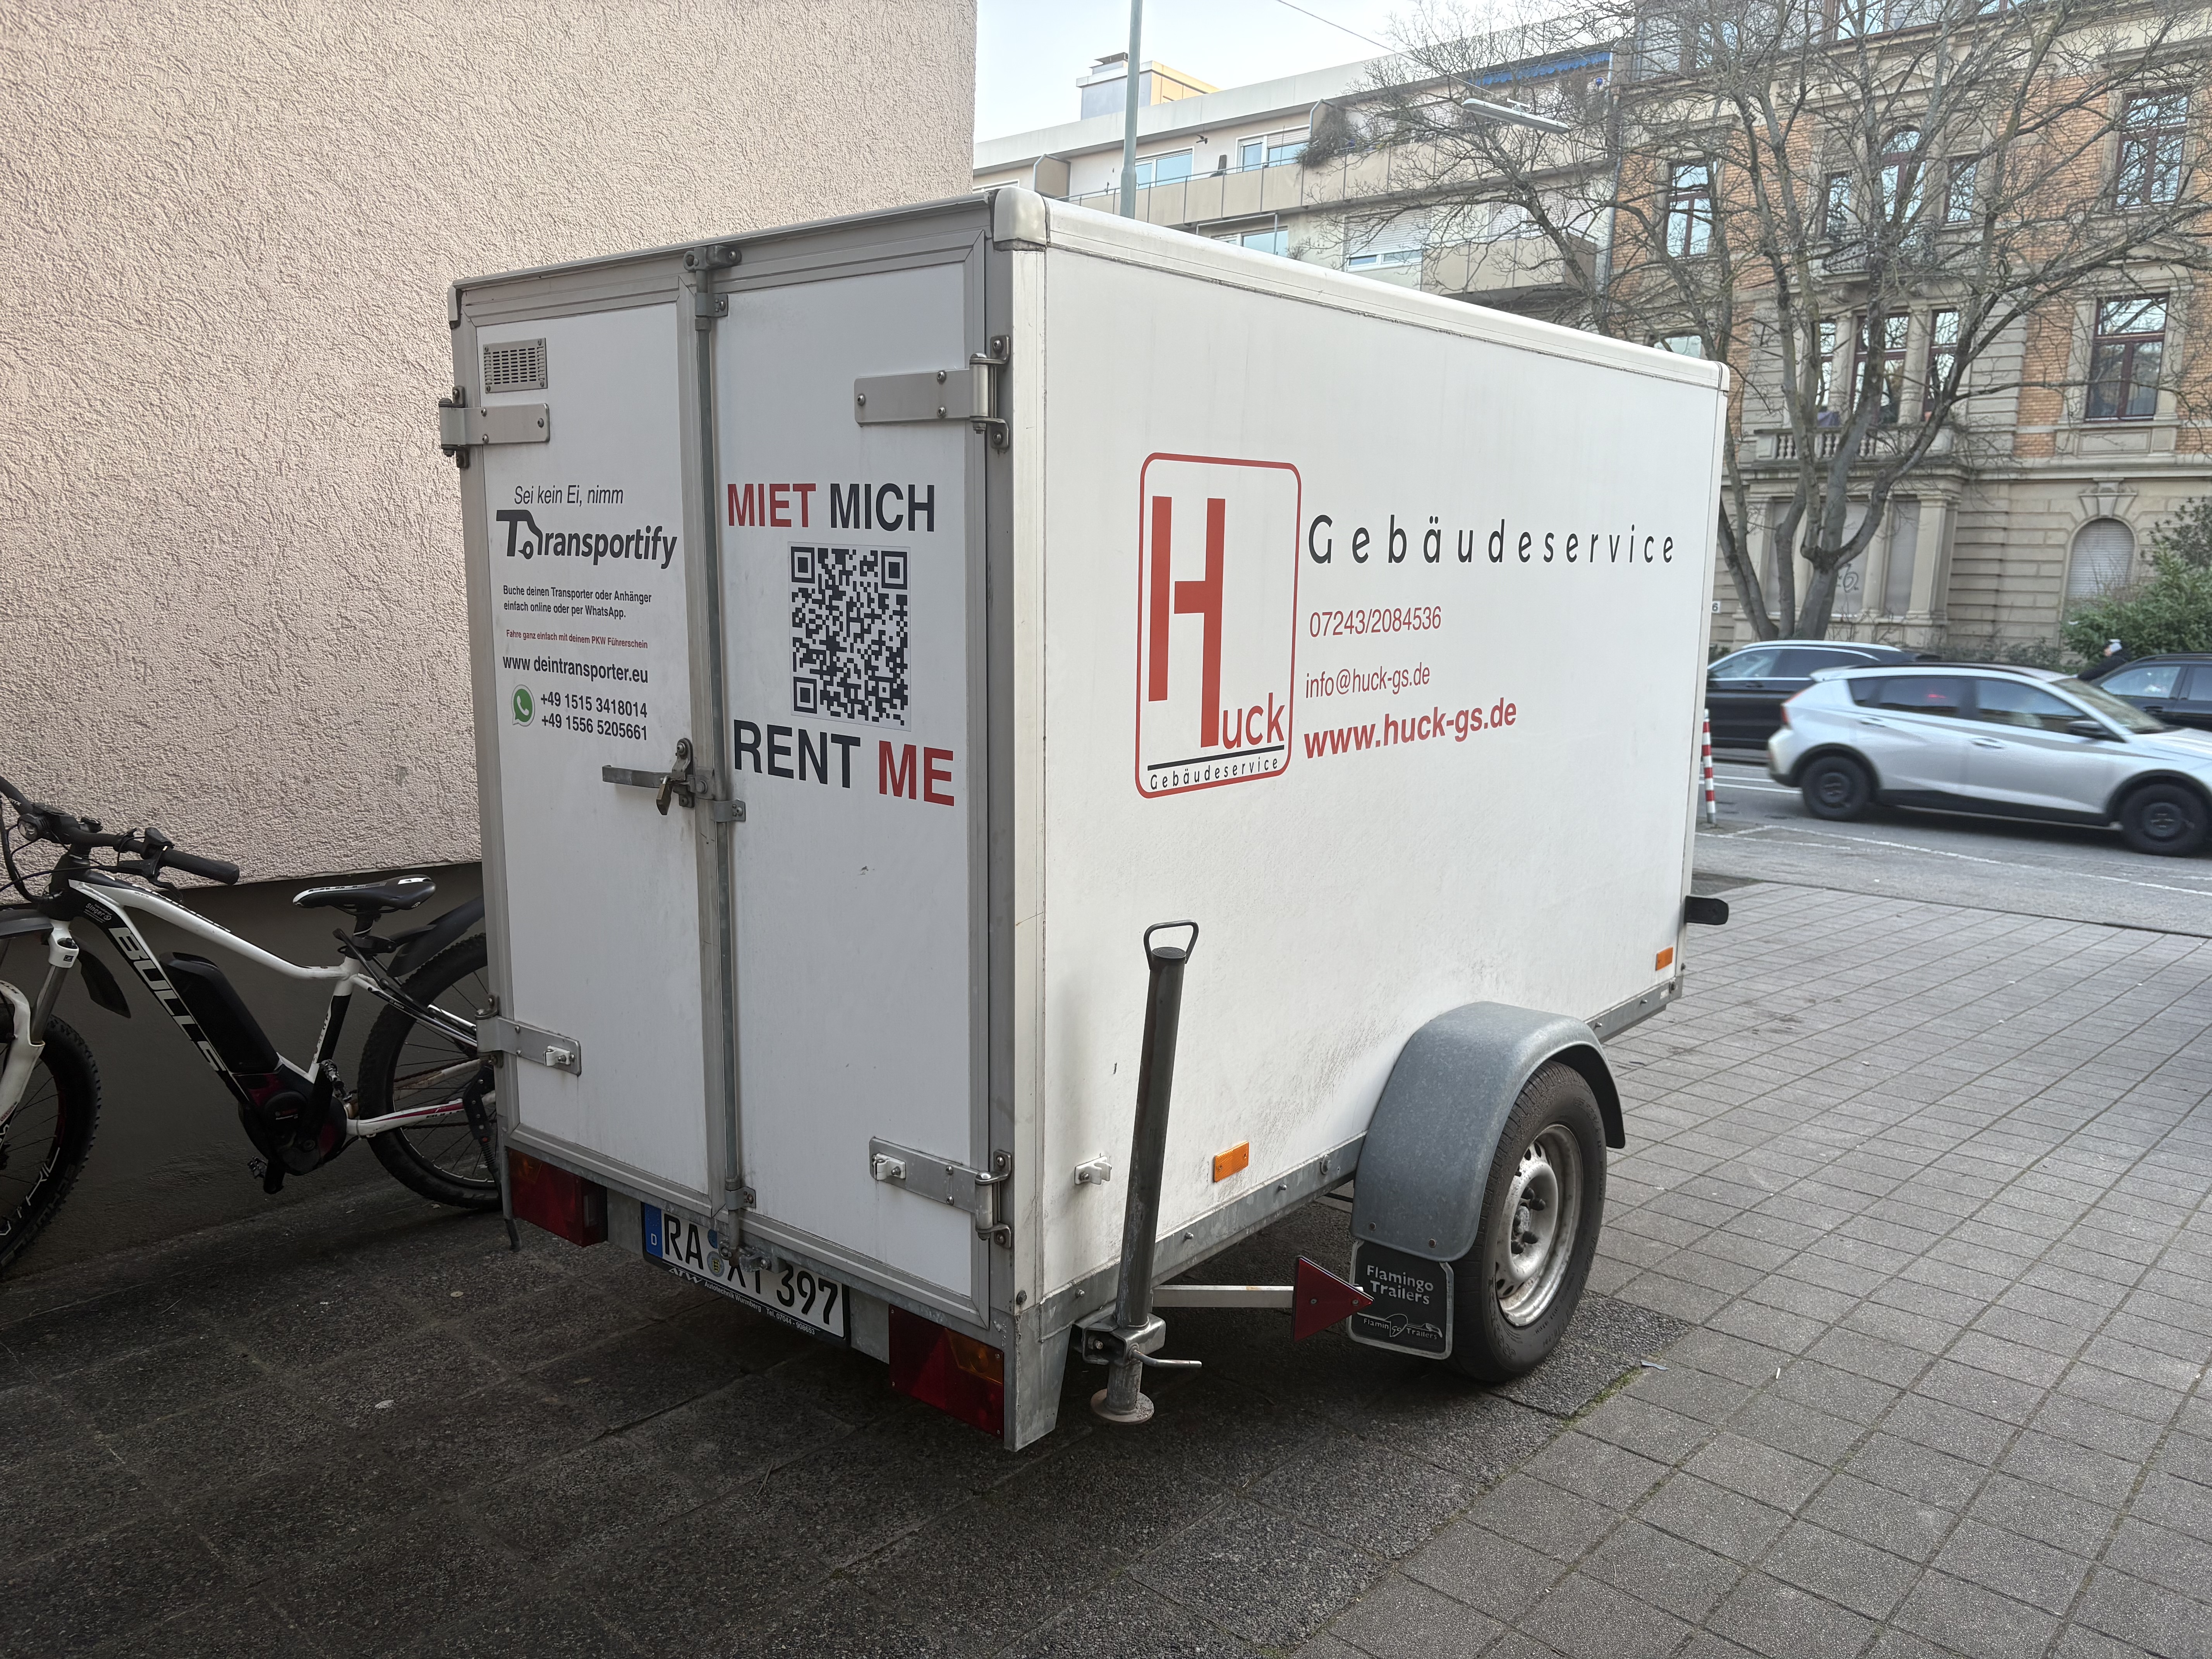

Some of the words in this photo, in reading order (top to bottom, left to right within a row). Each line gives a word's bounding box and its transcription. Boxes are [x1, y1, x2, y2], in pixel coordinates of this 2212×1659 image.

[514, 485, 534, 504] Sei
[537, 485, 562, 504] kein
[567, 485, 582, 507] Ei,
[587, 484, 623, 504] nimm
[728, 483, 816, 527] MIET
[830, 483, 935, 532] MICH
[496, 509, 678, 569] Transportify
[1309, 514, 1673, 564] Gebäudeservice
[503, 585, 525, 596] Buche
[526, 586, 549, 597] deinen
[551, 587, 593, 600] Transporter
[595, 590, 612, 601] oder
[614, 591, 652, 605] Anhänger
[504, 601, 528, 611] einfach
[530, 602, 551, 613] online
[553, 604, 569, 614] oder
[572, 606, 583, 617] per
[585, 605, 626, 620] WhatsApp.
[1148, 496, 1285, 750] Huck
[1310, 606, 1441, 637] 07243/2084536
[506, 630, 521, 639] Fahre
[537, 632, 557, 641] einfach
[559, 633, 568, 642] mit
[569, 634, 590, 644] deinem
[592, 636, 606, 645] PKW
[608, 637, 648, 649] Führerschein
[534, 656, 648, 683] deintransporter.eu
[1305, 662, 1430, 698] info@huck-gs.de
[541, 691, 561, 707] +49
[565, 694, 592, 711] 1515
[596, 697, 647, 718] 3418014
[542, 713, 562, 728] +49
[566, 715, 593, 733] 1556
[597, 720, 647, 740] 5205661
[1304, 697, 1517, 759] www.huck-gs.de
[734, 719, 860, 788] RENT
[879, 740, 955, 807] ME
[1151, 756, 1278, 790] Gebäudeservice
[108, 927, 227, 1071] BULLS
[651, 1233, 657, 1246] D
[664, 1213, 704, 1269] RA
[776, 1264, 838, 1325] 397
[668, 1267, 702, 1283] ATW
[1367, 1265, 1433, 1293] Flamingo
[1370, 1280, 1429, 1305] Trailers
[704, 1281, 735, 1299] Autotechnik
[735, 1294, 762, 1312] Wurmberg
[766, 1308, 775, 1318] Tel.
[776, 1314, 792, 1325] 07044
[796, 1322, 815, 1335] 908653
[1406, 1328, 1437, 1340] Trailers
